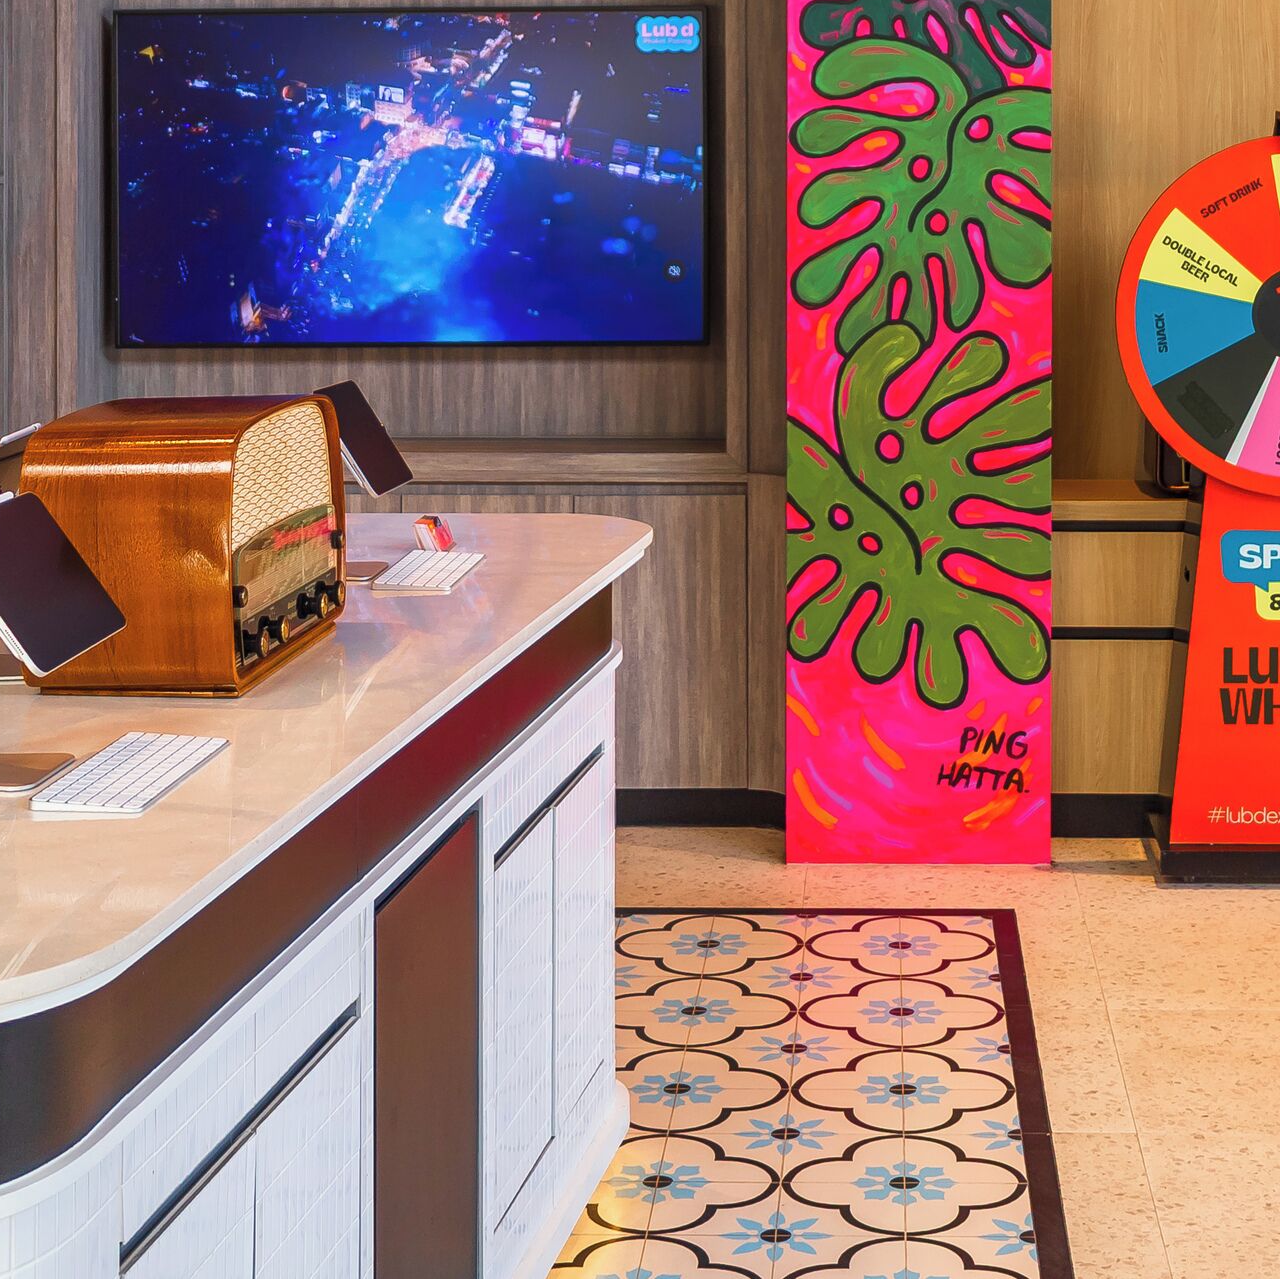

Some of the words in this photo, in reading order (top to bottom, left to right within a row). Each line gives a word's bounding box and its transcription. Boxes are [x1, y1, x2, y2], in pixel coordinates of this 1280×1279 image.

[641, 23, 678, 37] Lub
[681, 22, 694, 37] d
[1200, 196, 1229, 218] SOFT
[1228, 178, 1264, 203] DRINK
[1162, 235, 1206, 266] DOUBLE
[1204, 260, 1238, 287] LOCAL
[1181, 260, 1210, 283] BEER
[1154, 312, 1168, 353] SNACK
[959, 726, 1029, 760] PING
